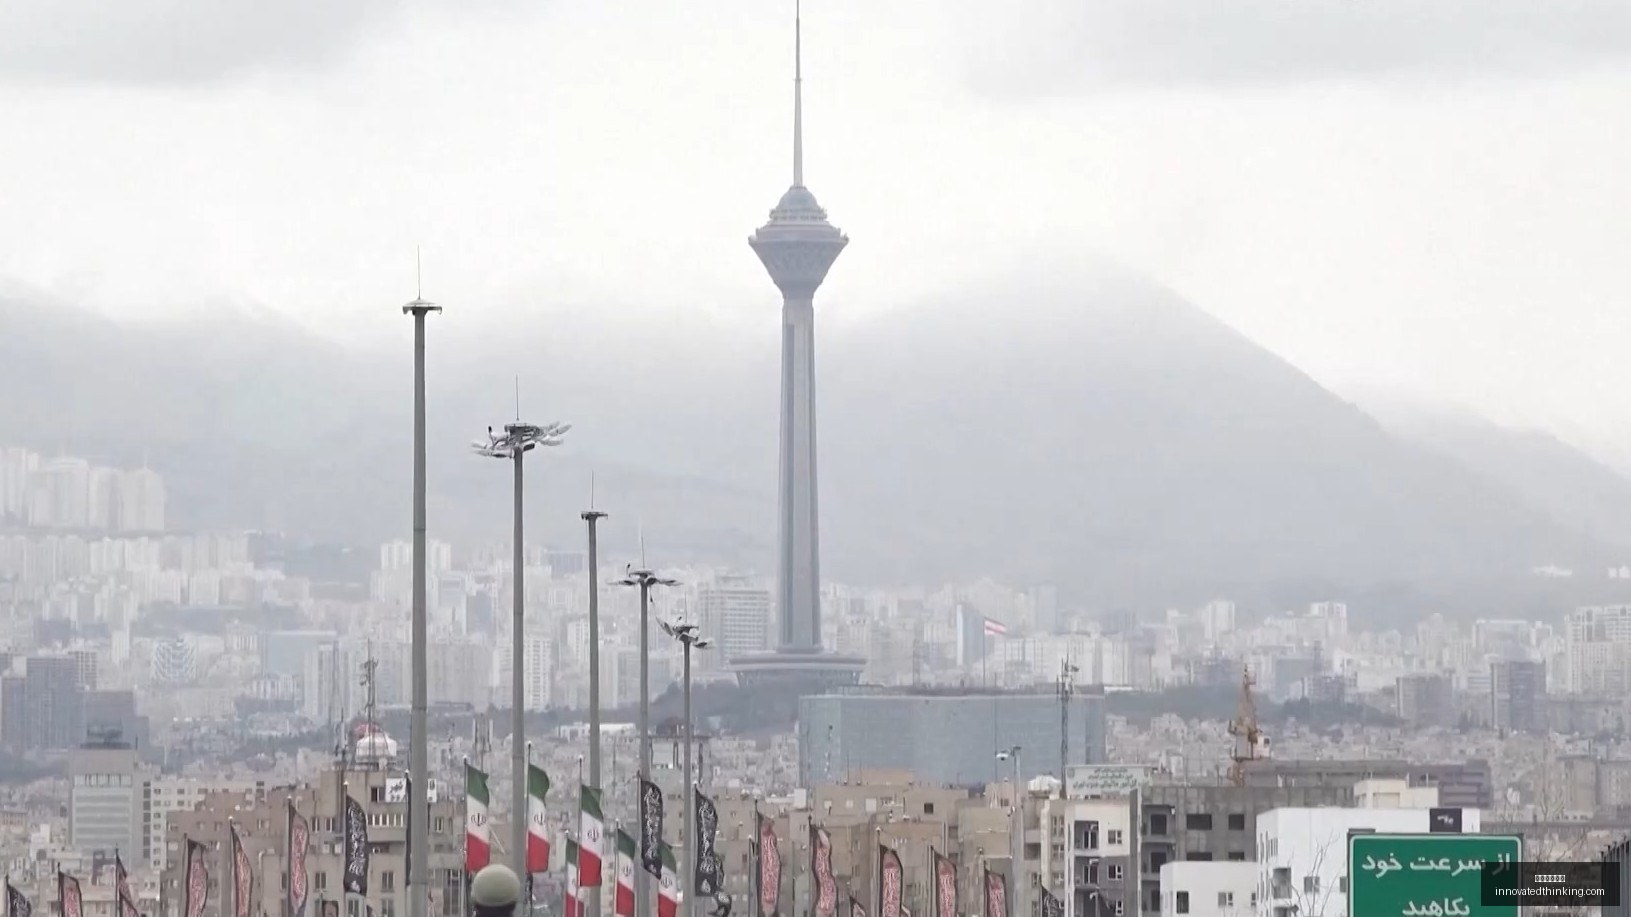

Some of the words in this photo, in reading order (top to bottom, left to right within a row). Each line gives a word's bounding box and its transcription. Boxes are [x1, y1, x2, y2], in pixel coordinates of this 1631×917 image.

[1361, 852, 1403, 879] خود
[1410, 856, 1487, 878] سرعت
[1492, 852, 1511, 876] از
